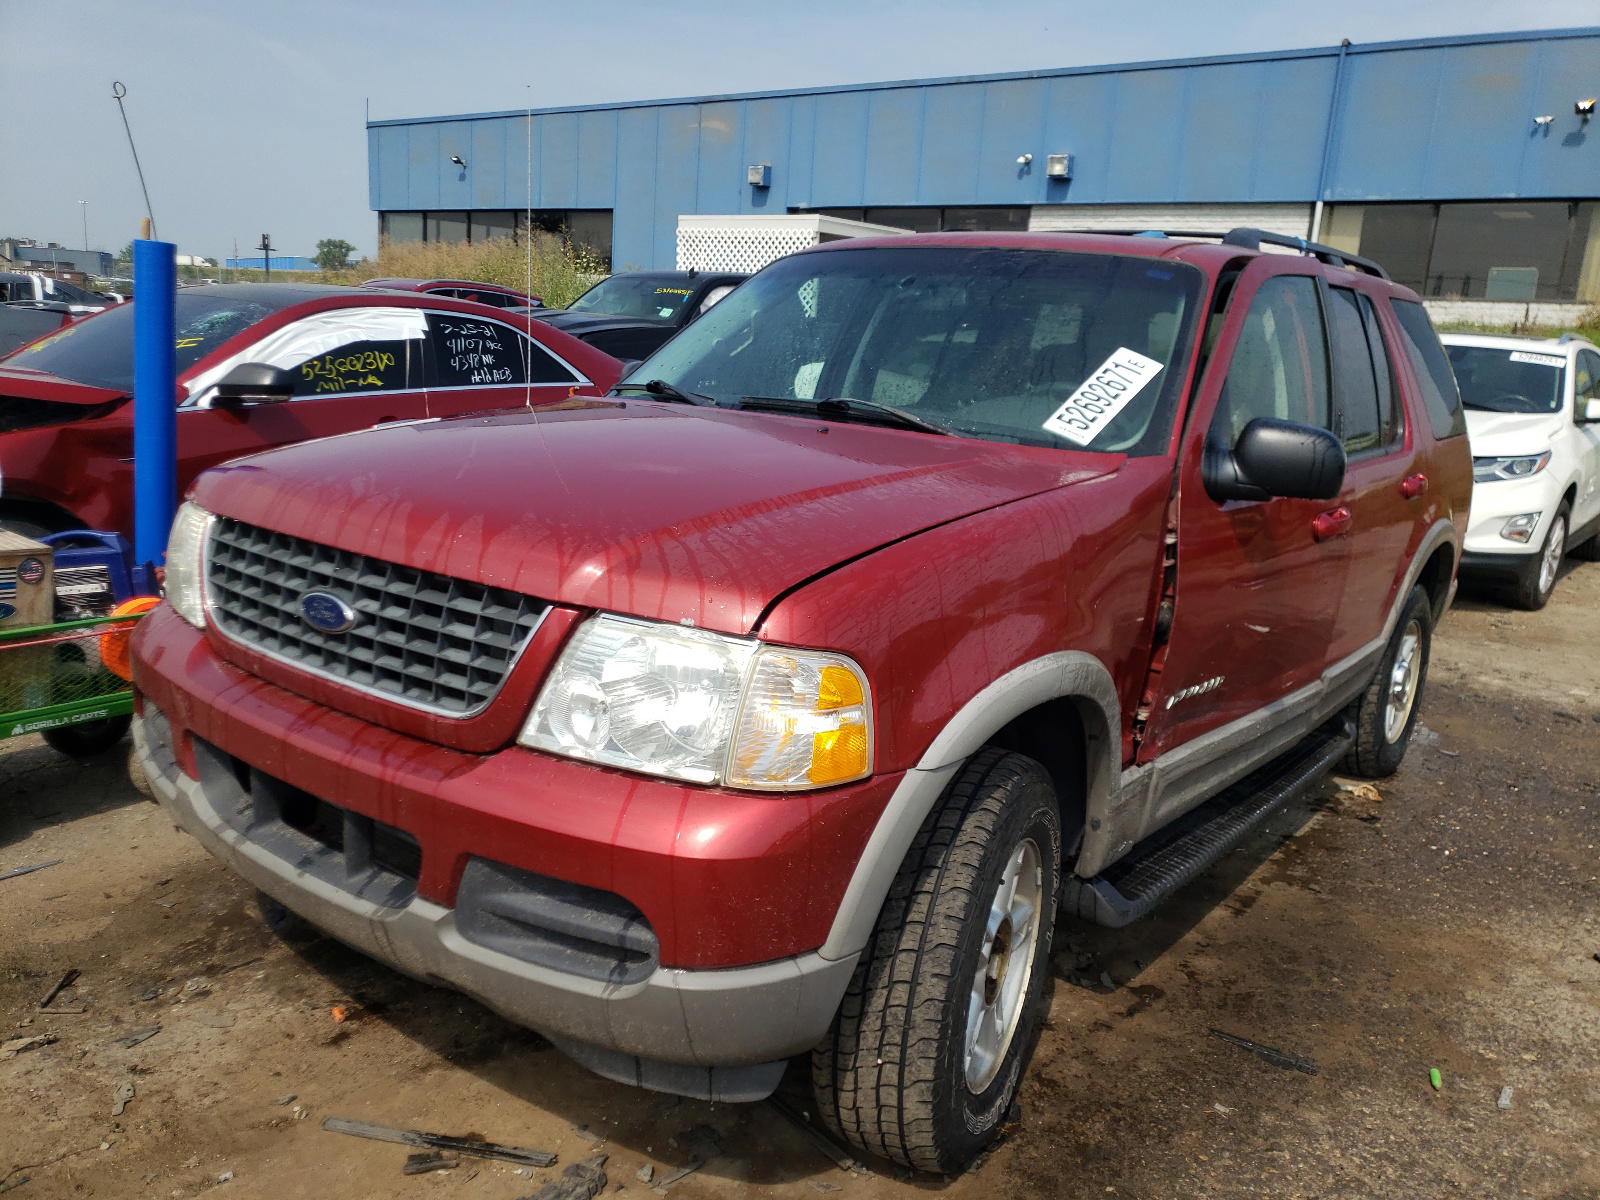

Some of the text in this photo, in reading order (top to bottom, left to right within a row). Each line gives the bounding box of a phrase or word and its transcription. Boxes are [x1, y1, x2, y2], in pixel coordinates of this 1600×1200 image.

[1056, 361, 1142, 431] 52692671
[25, 709, 109, 730] GORILLA CARTS
